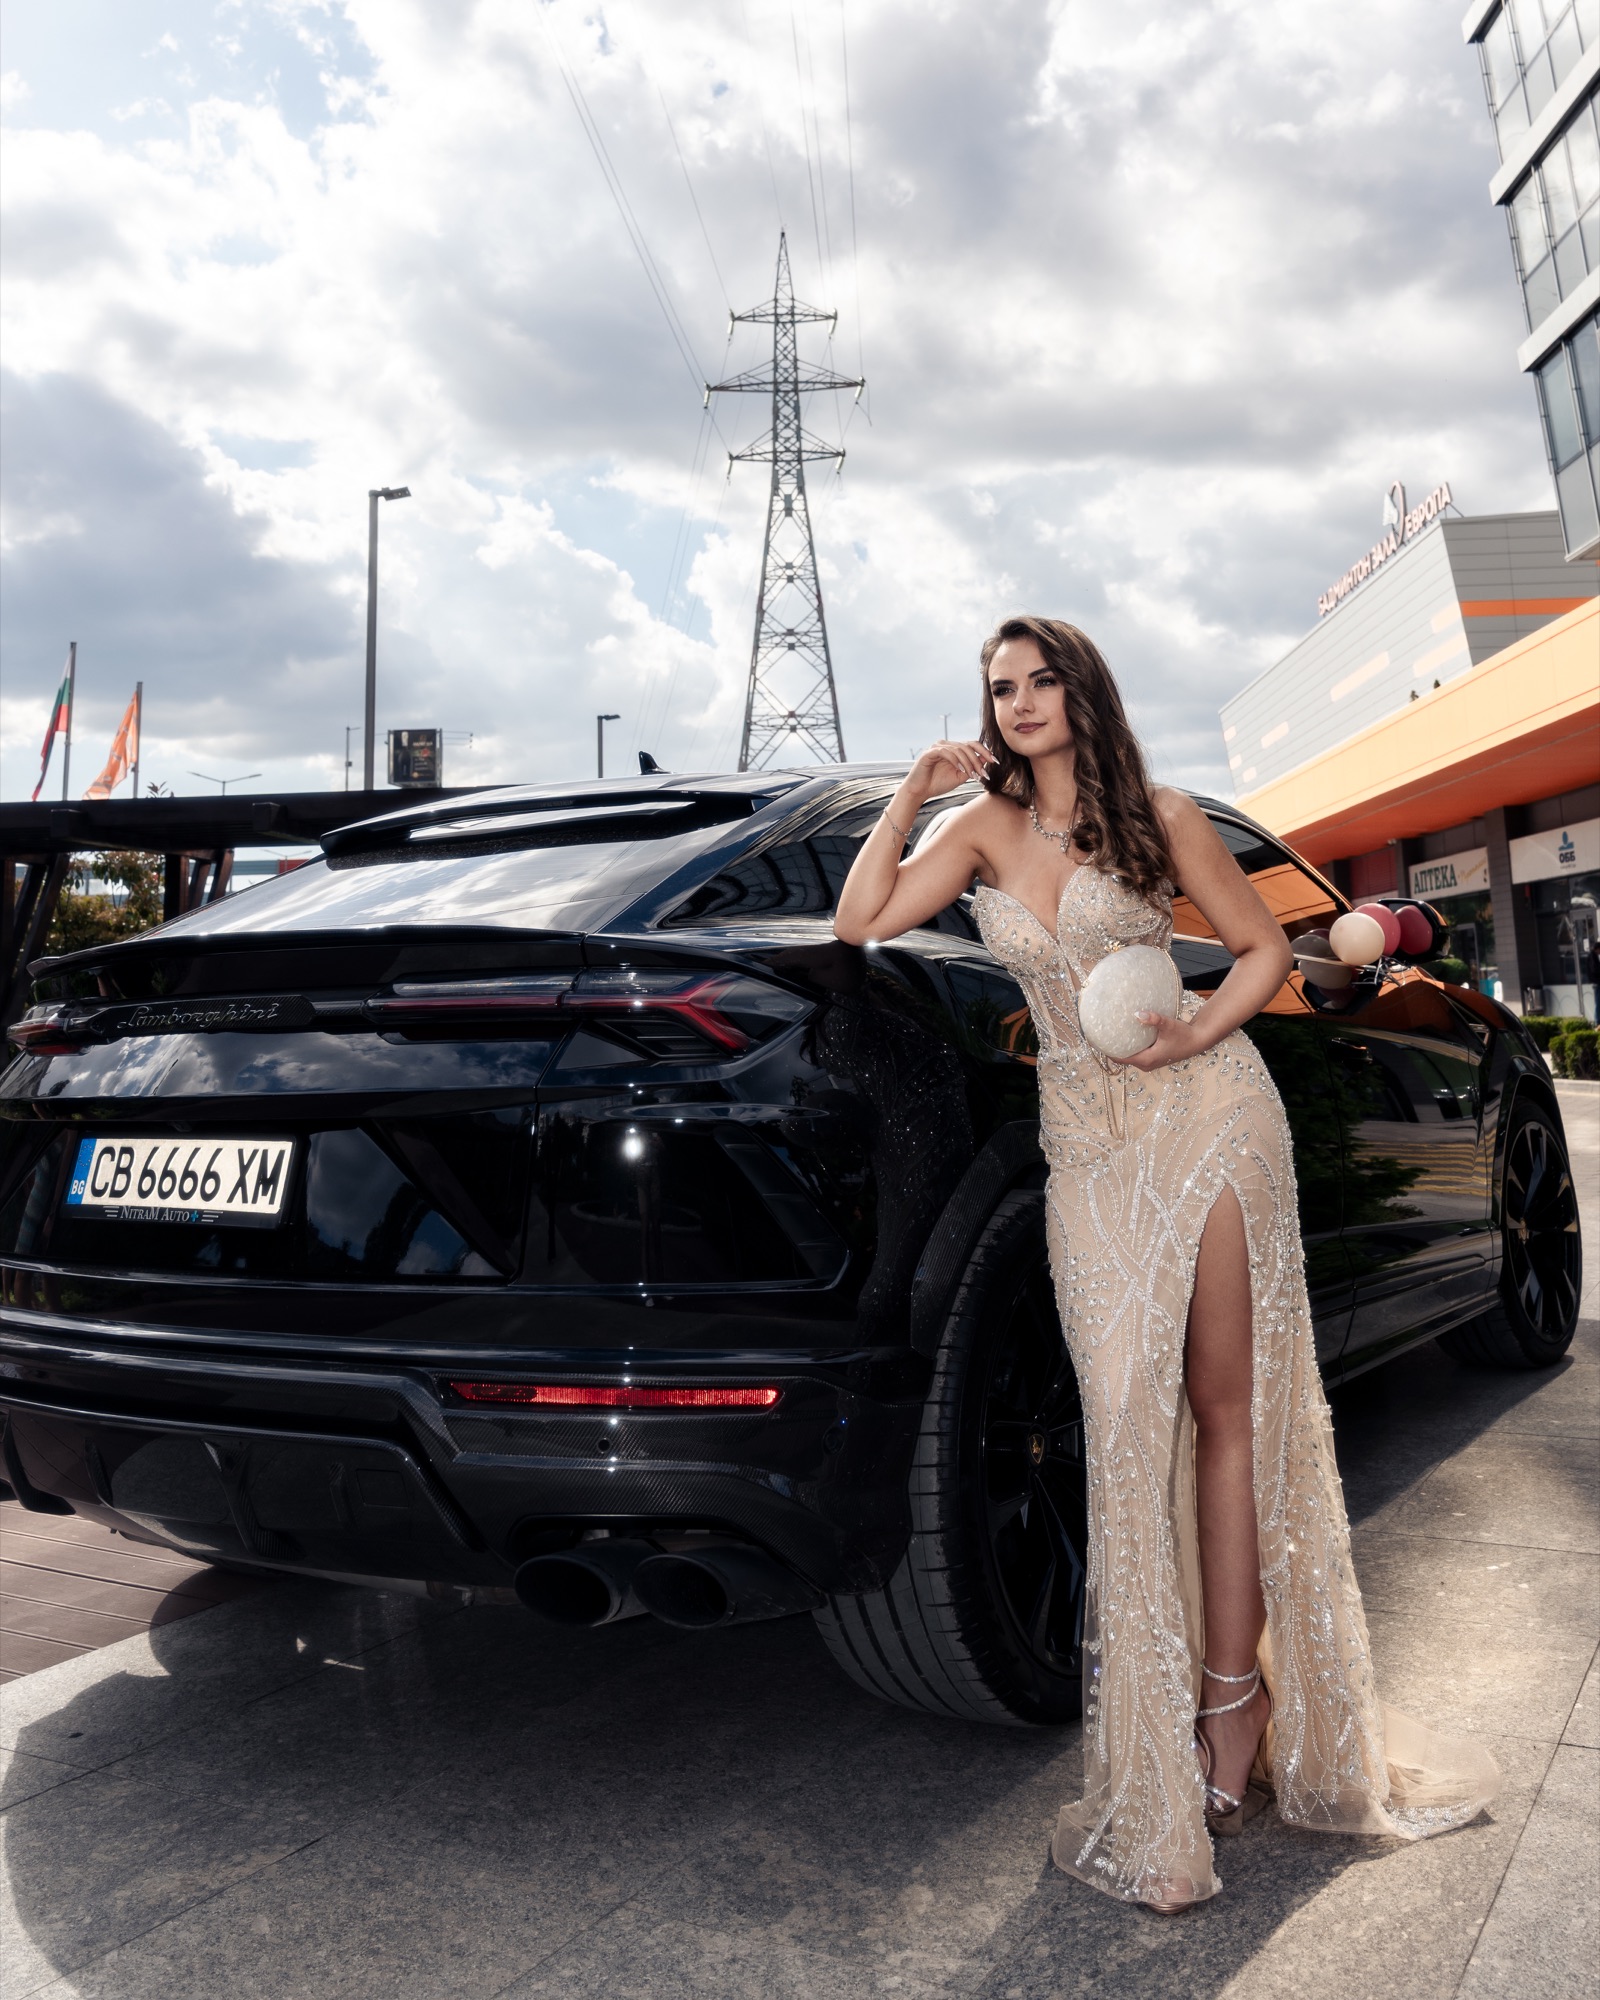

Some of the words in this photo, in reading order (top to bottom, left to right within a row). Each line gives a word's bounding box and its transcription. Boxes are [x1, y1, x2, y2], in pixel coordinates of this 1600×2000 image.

[1404, 482, 1452, 538] ЕВРОПА
[1414, 863, 1457, 895] АПТЕКА
[117, 1003, 279, 1029] Lamborghini
[70, 1179, 85, 1195] BG
[90, 1146, 135, 1199] CB
[137, 1146, 223, 1201] 6666
[226, 1148, 286, 1205] XM
